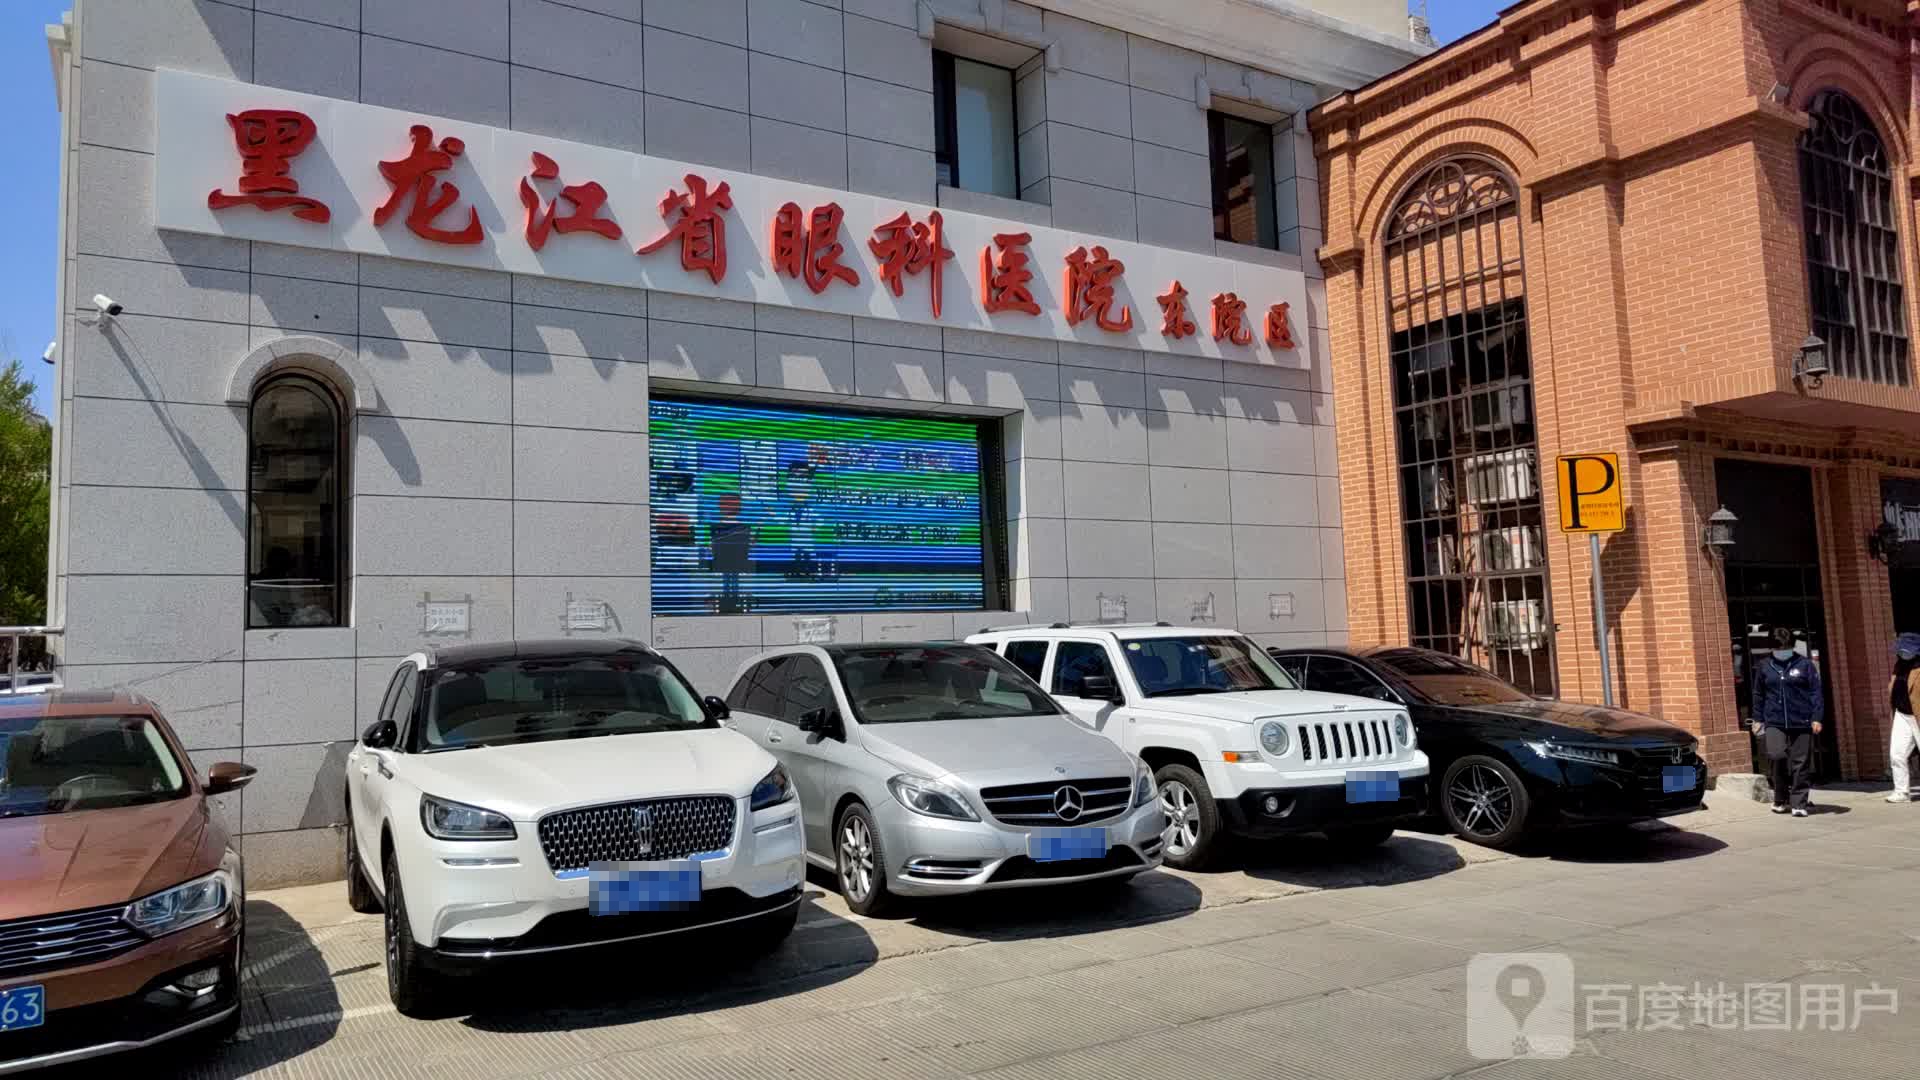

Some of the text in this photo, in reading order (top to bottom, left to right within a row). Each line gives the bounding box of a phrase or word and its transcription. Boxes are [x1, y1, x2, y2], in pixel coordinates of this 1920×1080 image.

[208, 109, 1296, 349] 黑龙江省眼科医院 东院区
[1560, 457, 1614, 528] P
